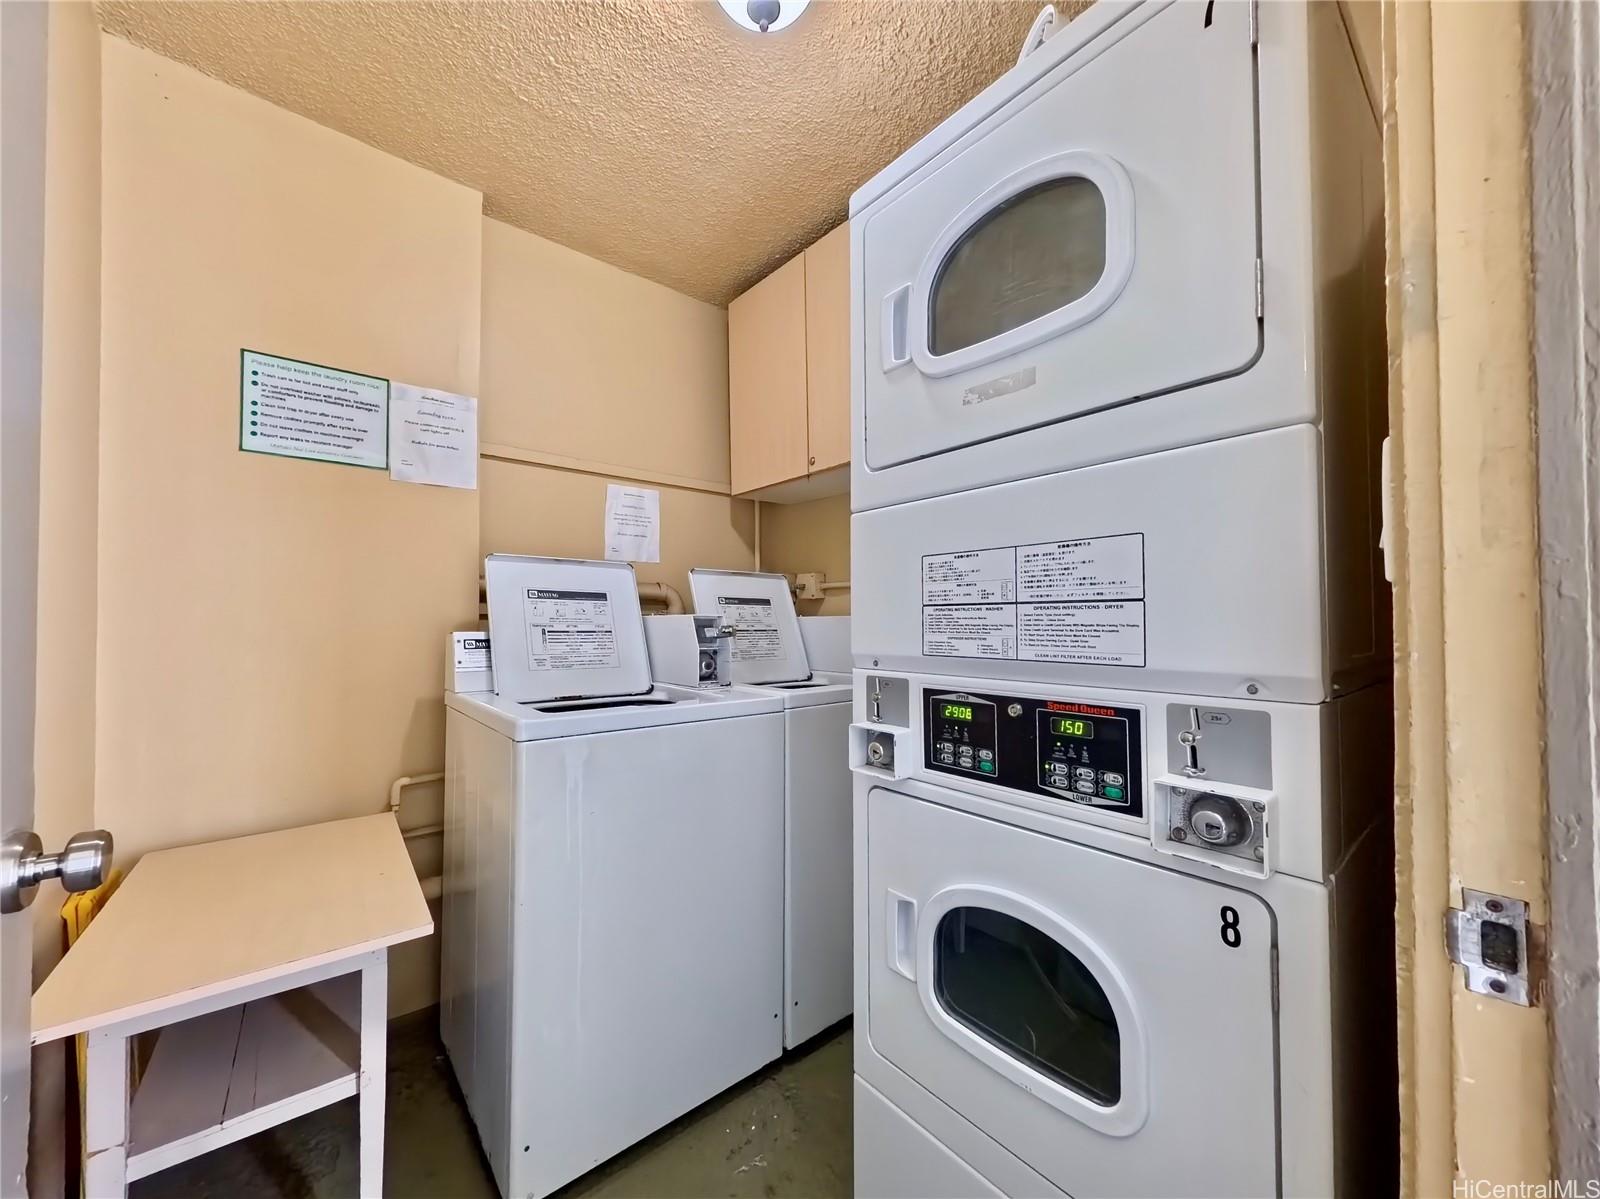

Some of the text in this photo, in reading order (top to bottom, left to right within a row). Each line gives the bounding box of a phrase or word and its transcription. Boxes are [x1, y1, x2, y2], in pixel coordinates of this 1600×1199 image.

[1061, 603, 1101, 611] INSTRUCTIONS
[1104, 602, 1125, 610] DRYER
[1047, 701, 1116, 717] Speed Queen
[1060, 719, 1084, 736] 150
[1072, 792, 1093, 804] LOWER
[1220, 905, 1242, 948] 8
